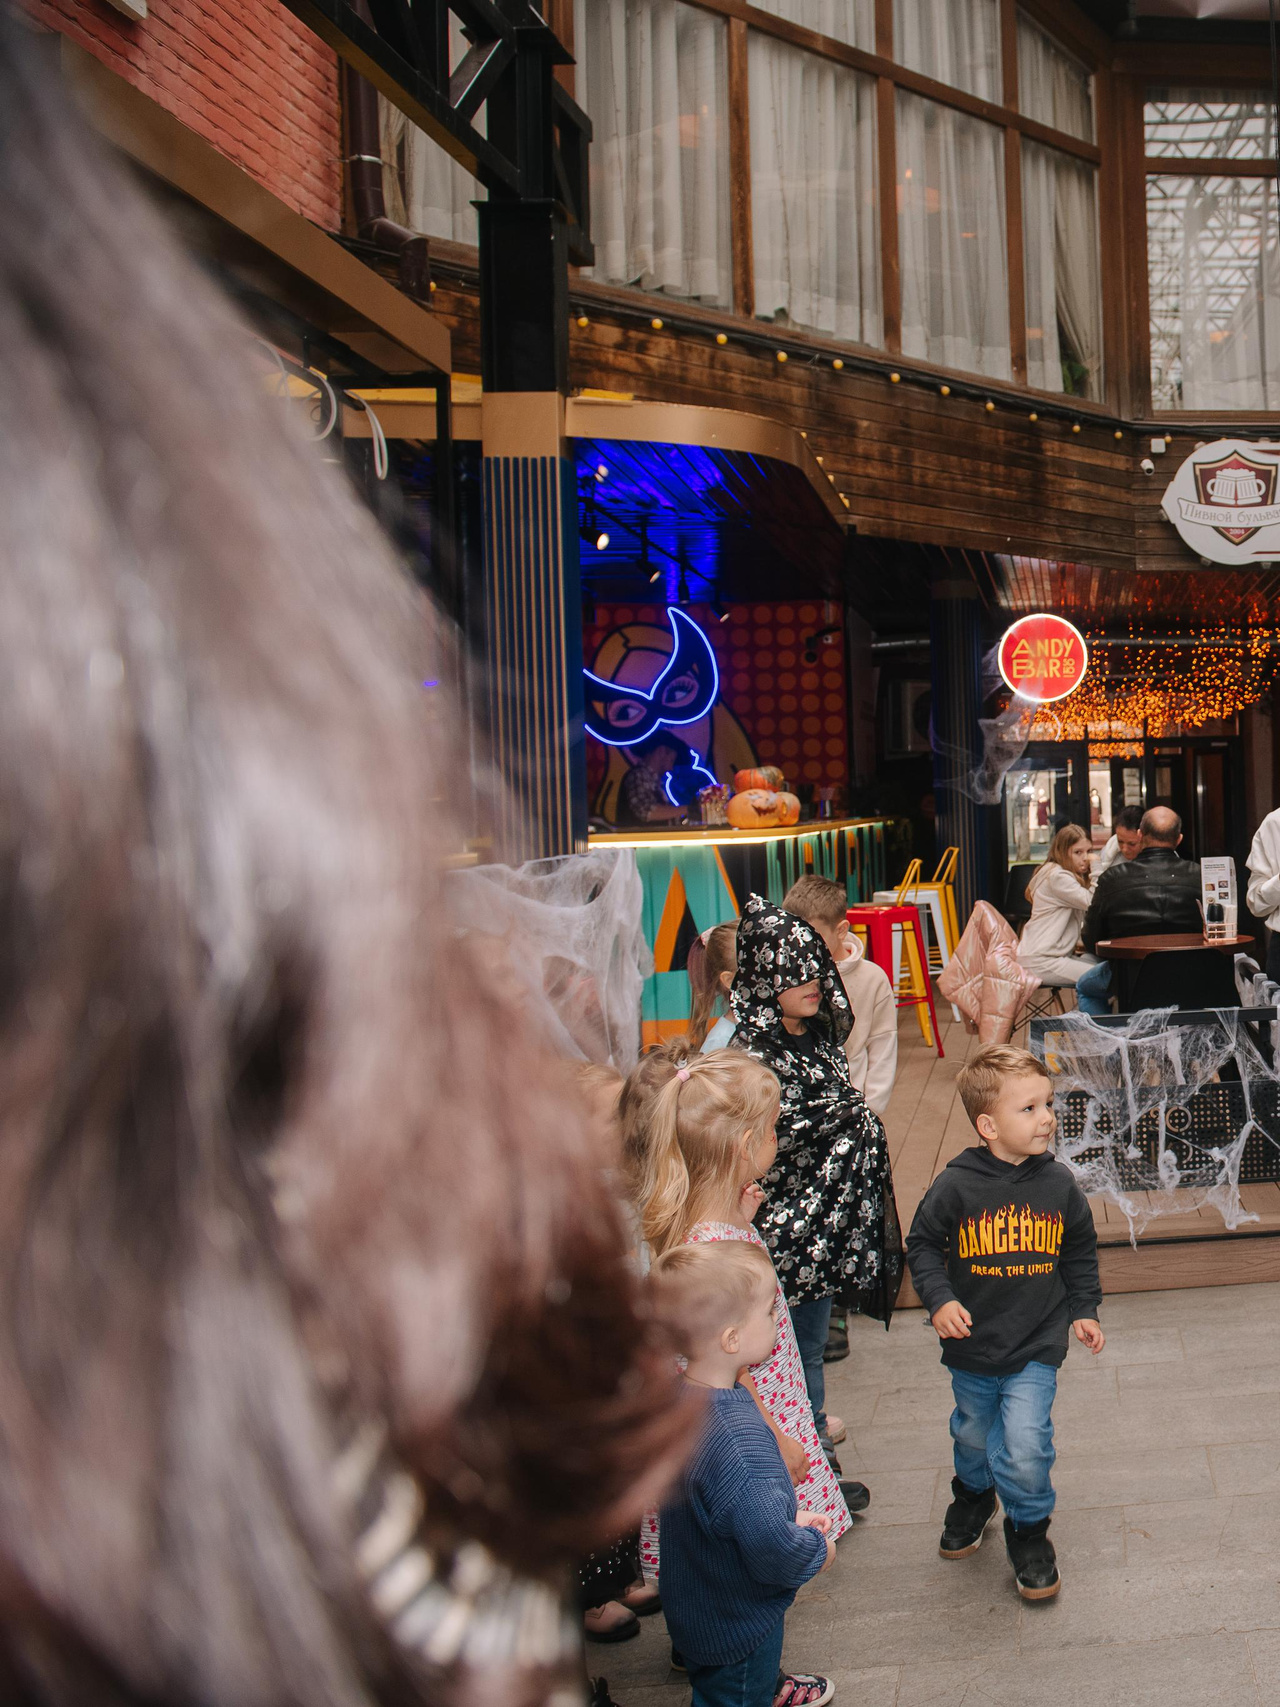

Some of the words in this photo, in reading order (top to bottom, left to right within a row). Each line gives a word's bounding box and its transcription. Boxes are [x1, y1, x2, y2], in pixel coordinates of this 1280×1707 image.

[1184, 503, 1232, 523] Пивной
[1011, 638, 1074, 658] ANDY
[1012, 659, 1061, 678] BAR
[971, 1264, 1003, 1277] BREAK
[1006, 1264, 1025, 1278] THE
[1027, 1262, 1054, 1276] LIMITS
